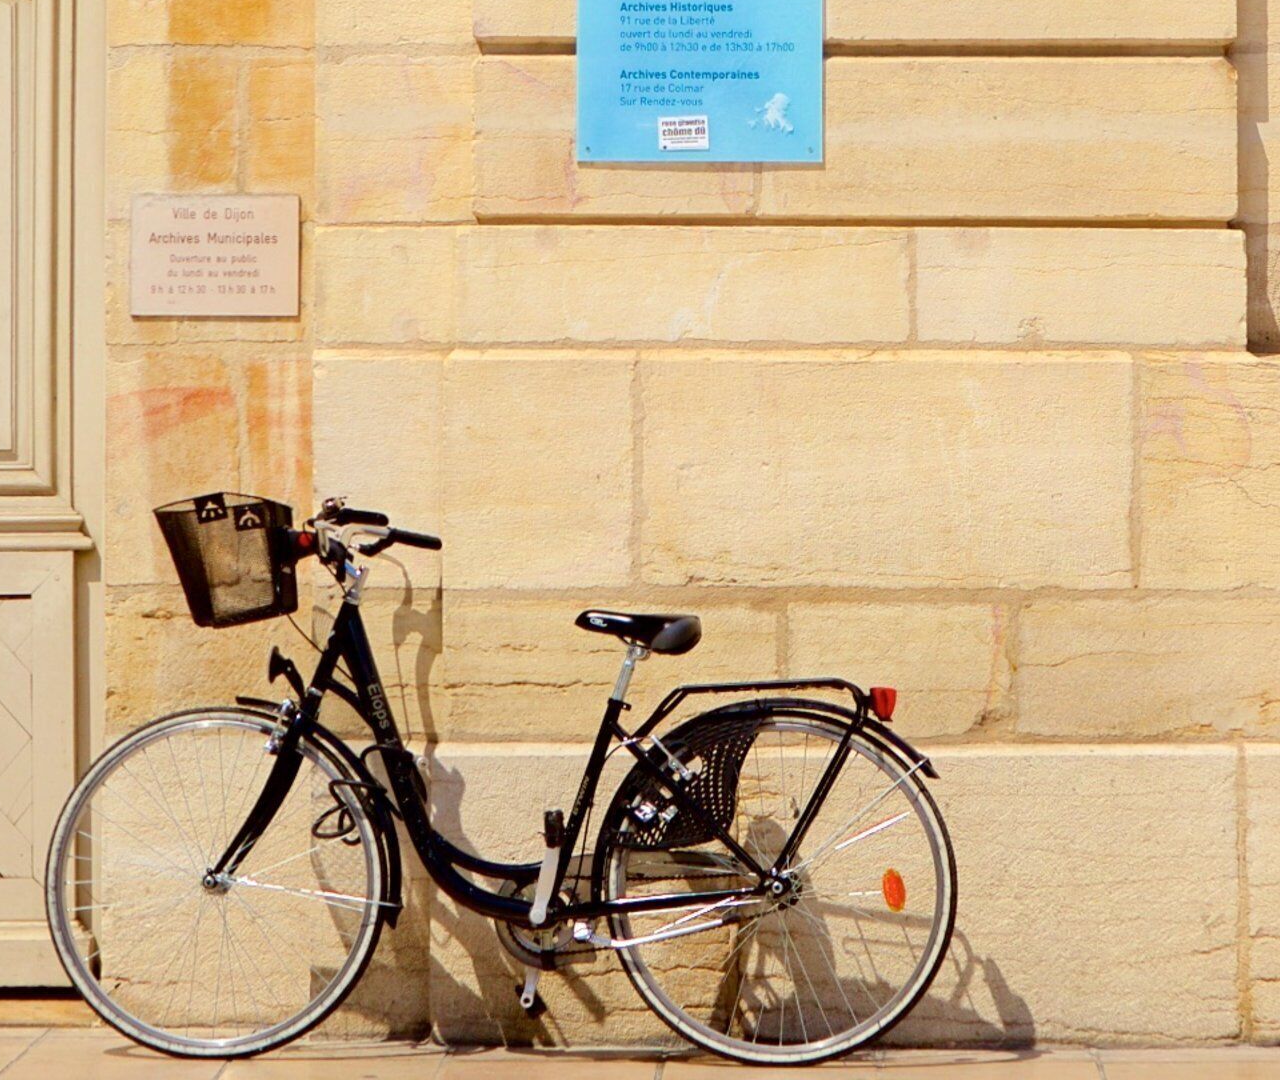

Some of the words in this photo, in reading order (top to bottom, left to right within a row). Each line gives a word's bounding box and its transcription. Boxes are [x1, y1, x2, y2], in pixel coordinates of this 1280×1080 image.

[620, 2, 667, 12] Archives
[670, 2, 734, 14] Historiques
[620, 16, 631, 25] 91
[634, 17, 651, 25] rue
[653, 16, 666, 25] de
[668, 16, 678, 25] la
[680, 16, 715, 25] Liberté
[653, 30, 666, 39] du
[668, 30, 694, 39] lundi
[696, 31, 708, 39] au
[710, 30, 753, 39] vendredi
[620, 43, 632, 52] de
[709, 43, 722, 52] de
[620, 70, 667, 79] Archives
[670, 70, 760, 81] Contemporaines
[620, 84, 631, 93] 17
[653, 84, 666, 93] de
[668, 84, 704, 93] Colmar
[620, 97, 637, 106] Sur
[640, 97, 704, 106] Rendez-vous
[172, 208, 197, 220] Ville
[203, 208, 218, 220] de
[224, 208, 255, 222] Dijon
[149, 233, 200, 245] Archives
[207, 232, 278, 246] Municipales
[169, 254, 212, 263] Ouverture
[216, 255, 227, 263] au
[231, 254, 257, 264] public
[167, 269, 178, 277] du
[182, 269, 204, 277] lundi
[223, 269, 260, 277] vendredi
[367, 683, 390, 730] Elops
